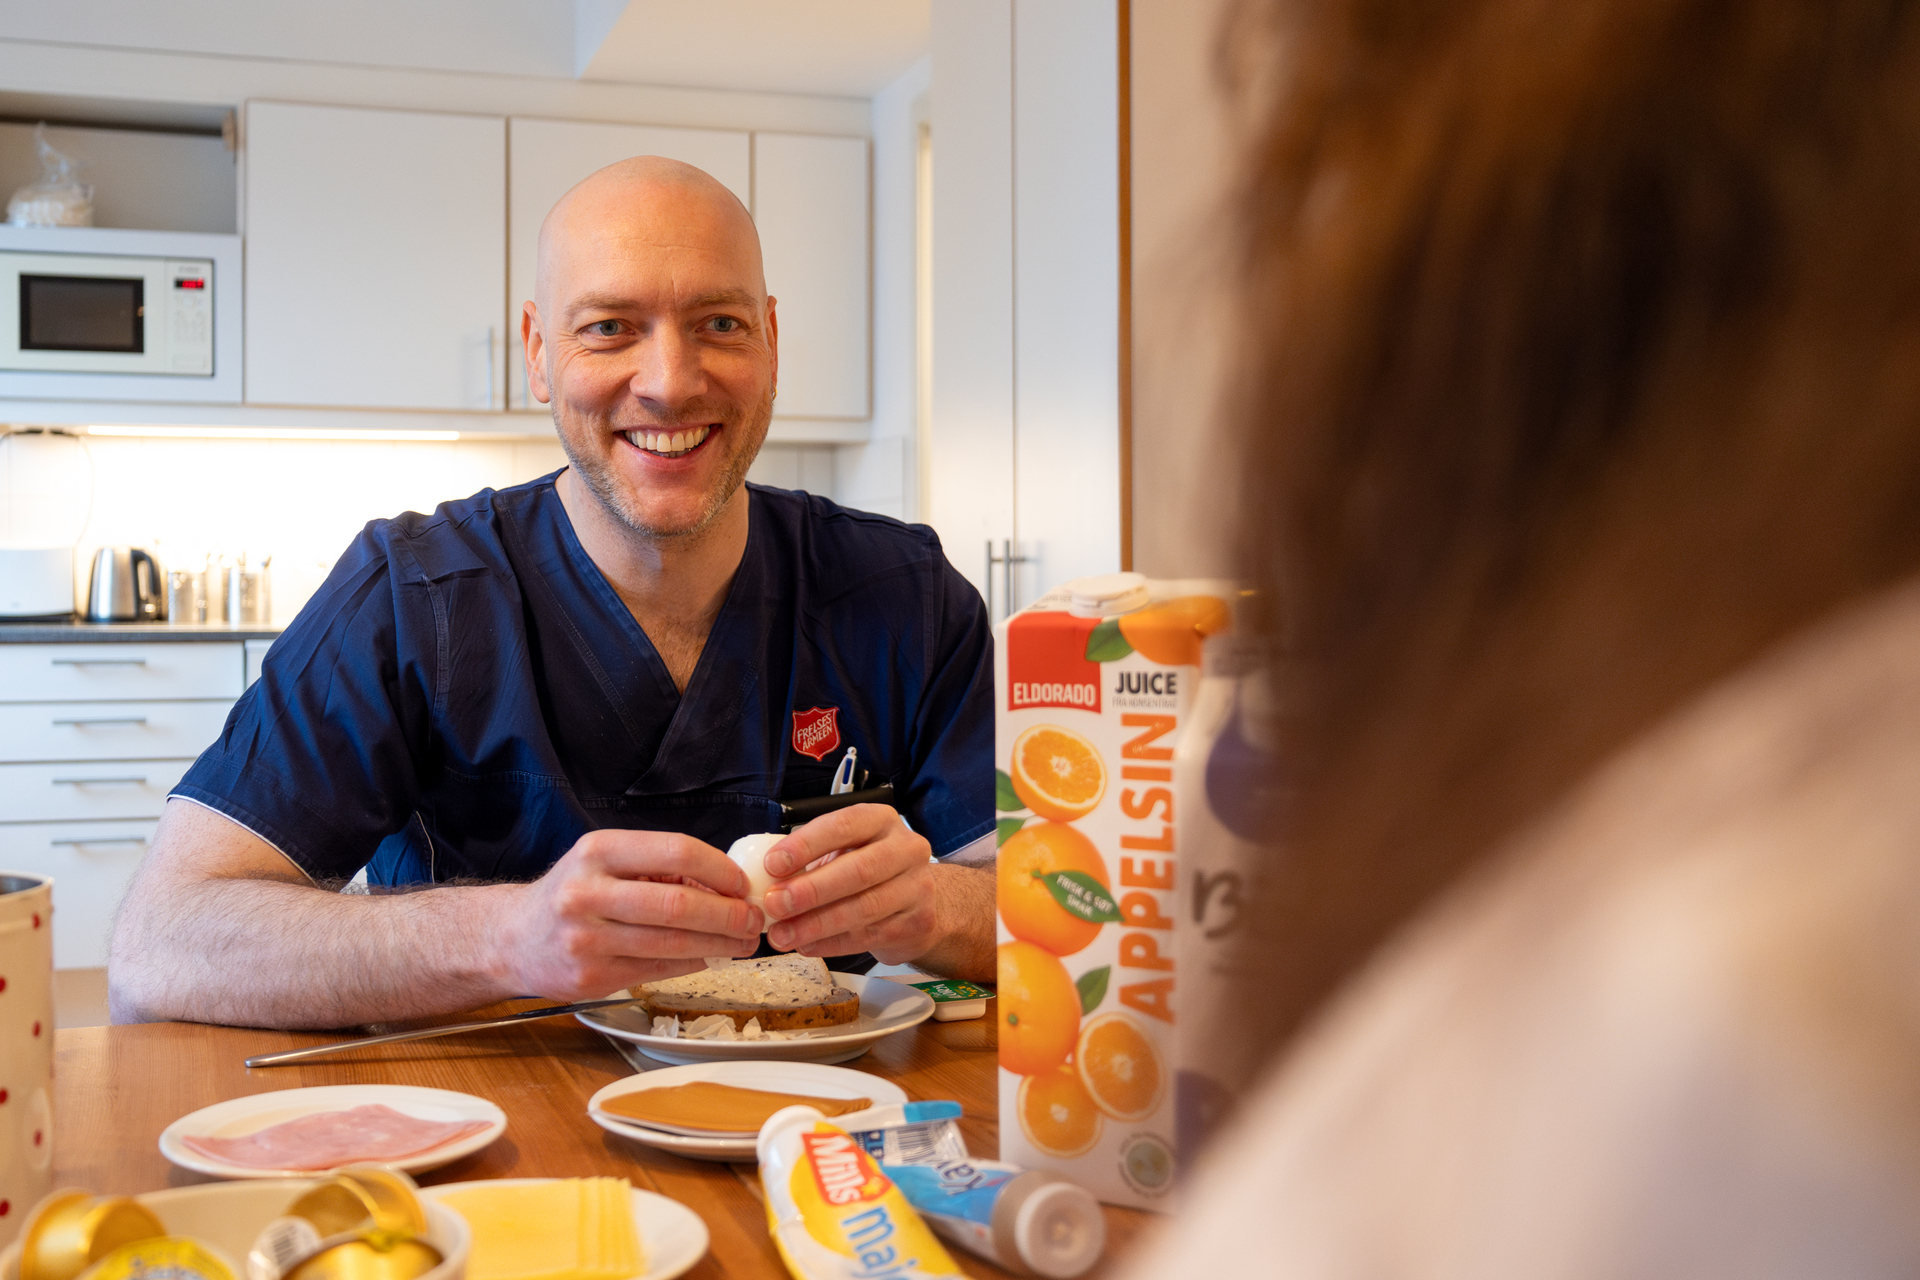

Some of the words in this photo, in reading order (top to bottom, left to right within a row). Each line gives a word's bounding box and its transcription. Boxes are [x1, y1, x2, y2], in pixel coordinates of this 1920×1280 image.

[1012, 682, 1096, 706] ELDORADO
[1115, 671, 1177, 695] JUICE
[1112, 697, 1127, 708] FRA
[802, 723, 833, 752] ARMEEN
[1119, 712, 1177, 1026] APPELSIN
[1056, 874, 1086, 899] FRISK
[1066, 893, 1094, 918] SMAK
[809, 1134, 866, 1204] Mills
[841, 1206, 919, 1280] maj
